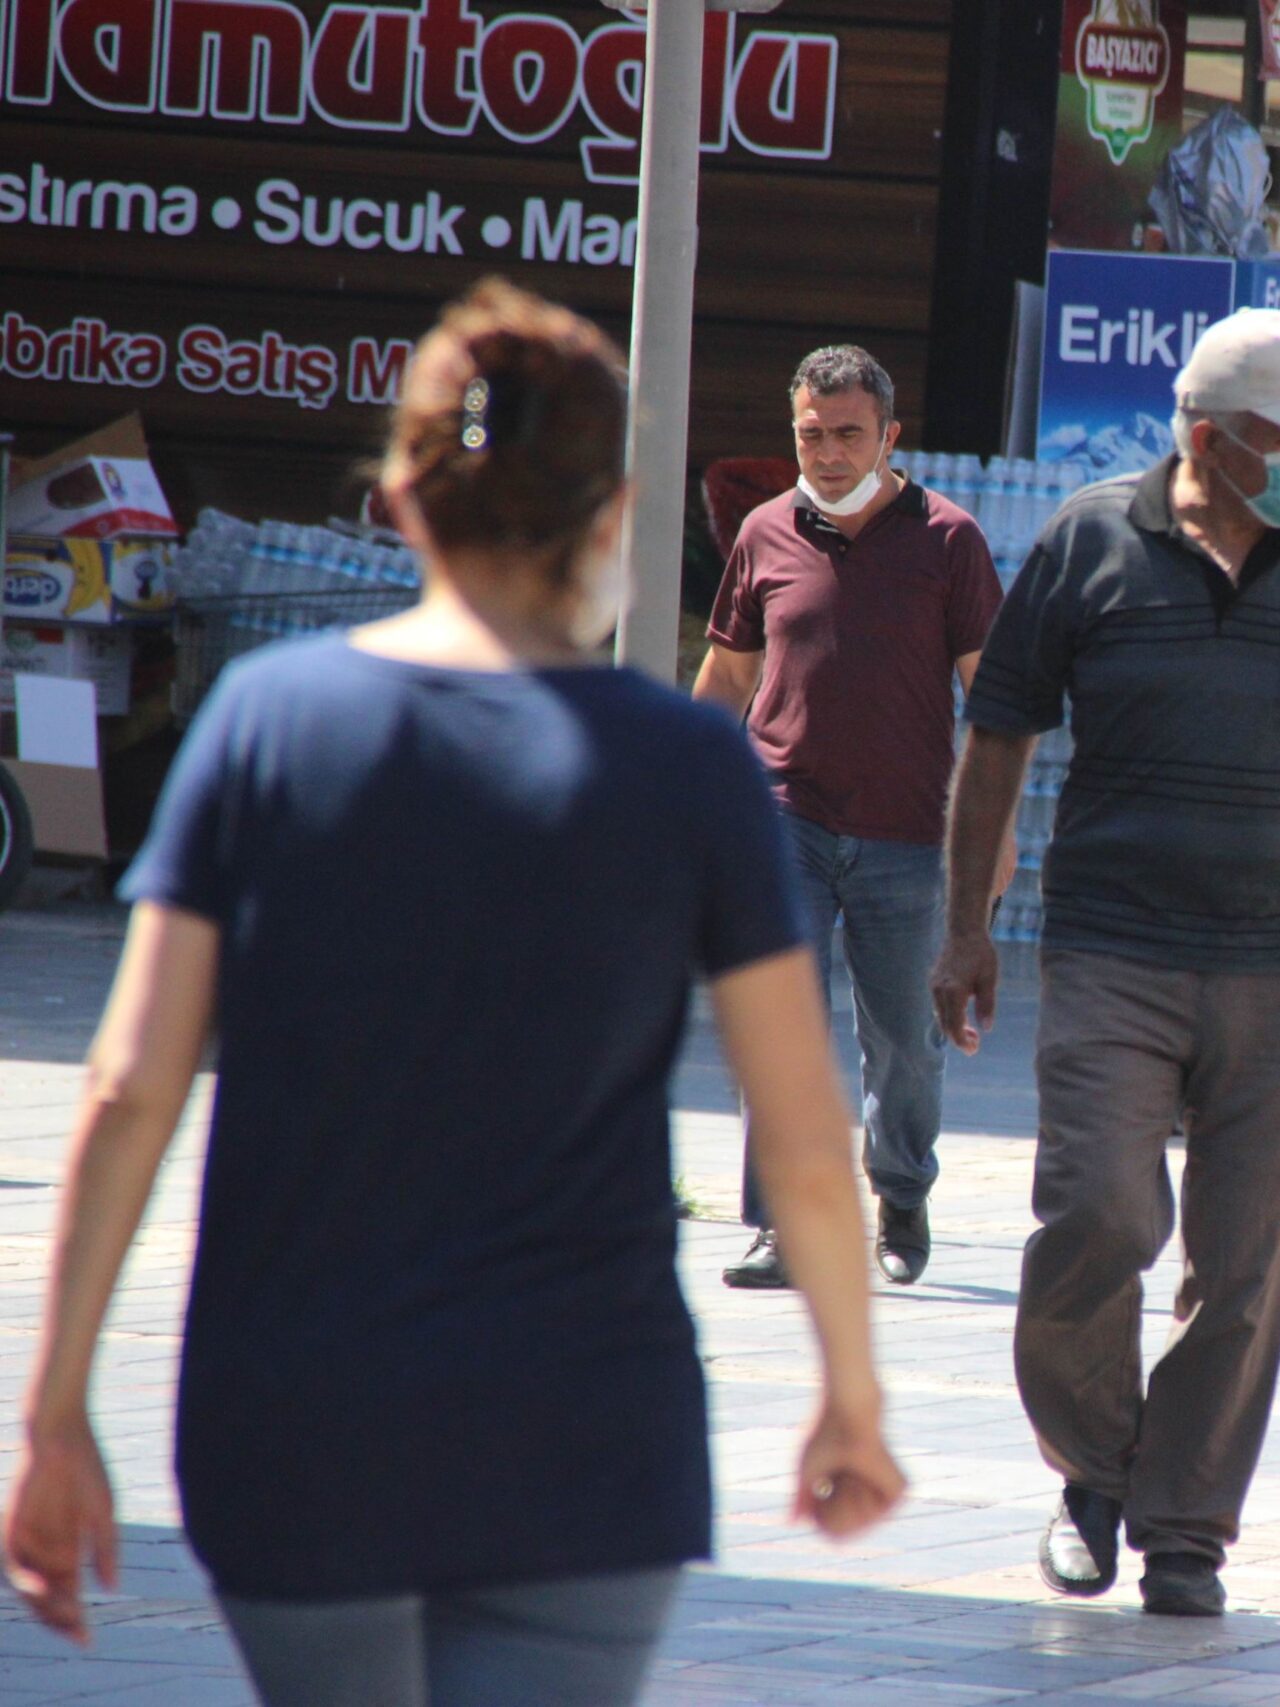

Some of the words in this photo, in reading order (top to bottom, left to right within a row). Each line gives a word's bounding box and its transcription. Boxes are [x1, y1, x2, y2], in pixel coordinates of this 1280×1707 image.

[1086, 33, 1159, 78] BAŞYAZICI
[0, 162, 198, 236] stırma
[254, 179, 464, 255] Sucuk
[178, 323, 338, 409] Satış
